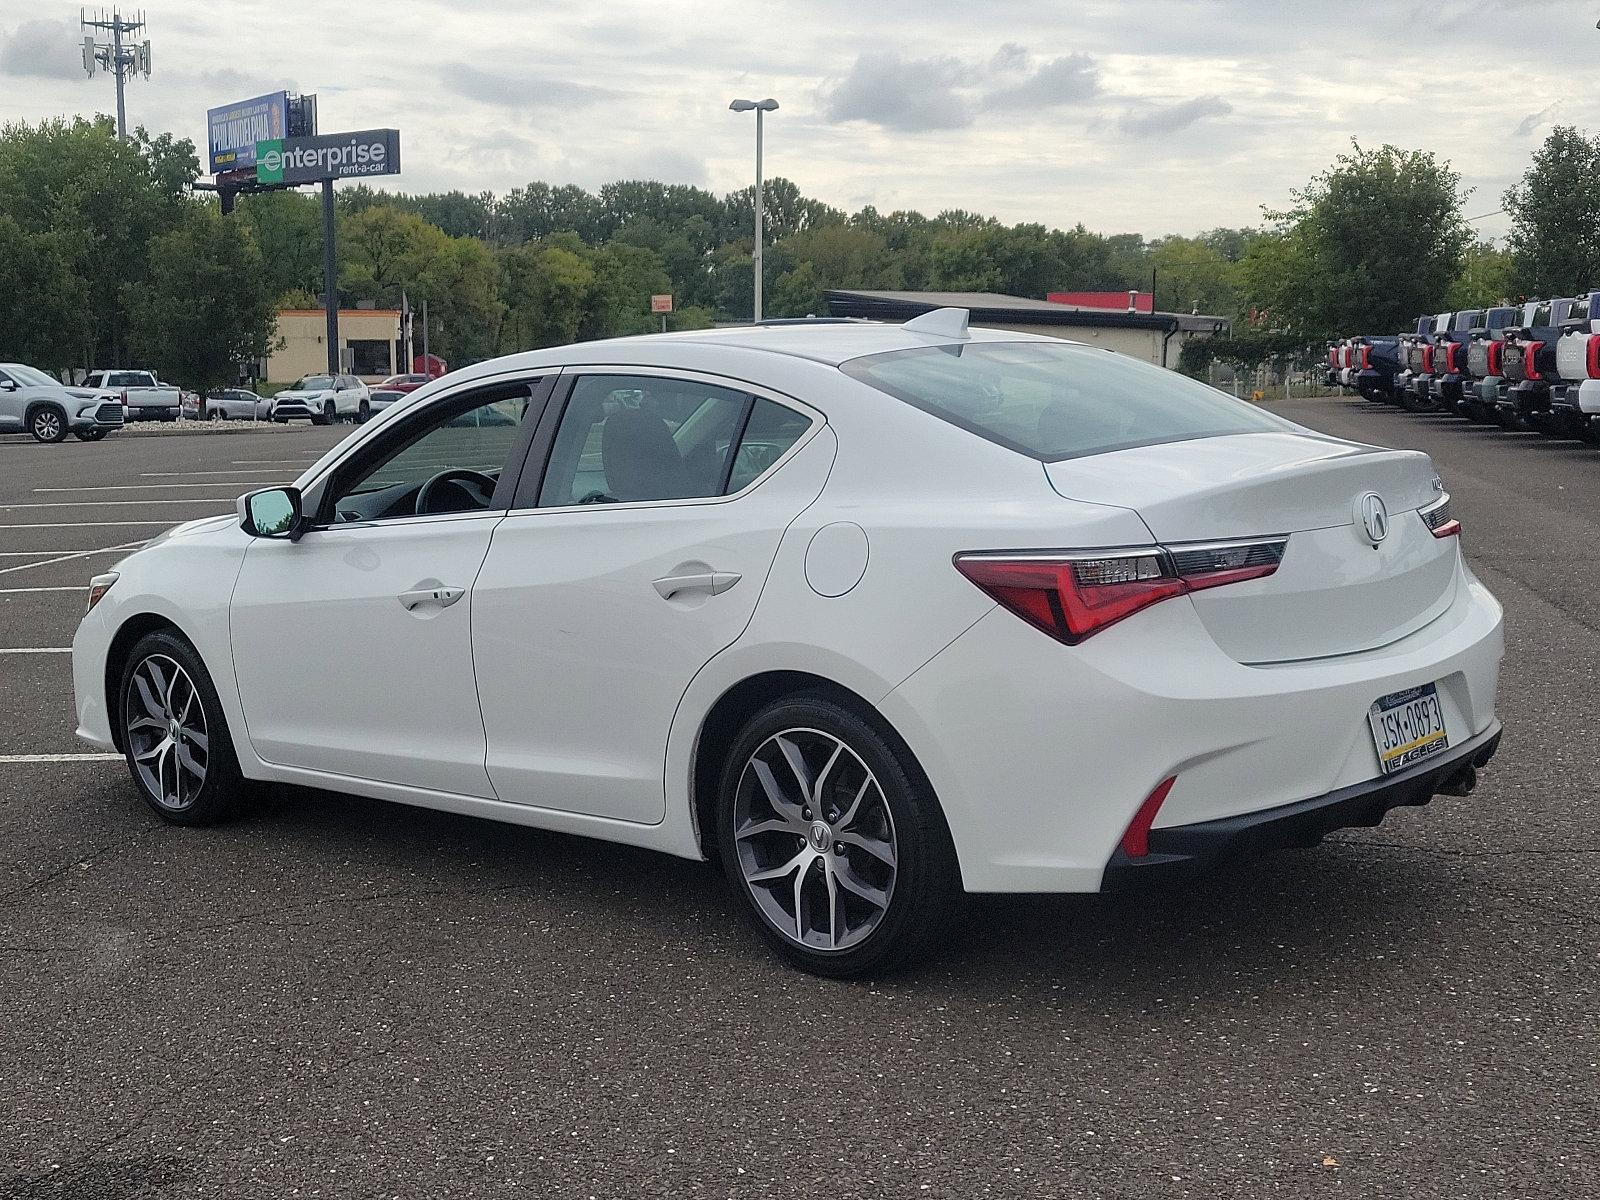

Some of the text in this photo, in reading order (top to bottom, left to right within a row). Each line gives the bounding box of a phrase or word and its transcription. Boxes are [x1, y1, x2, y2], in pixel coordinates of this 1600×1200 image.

[264, 139, 385, 171] enterprise
[339, 162, 385, 175] rent-a-car
[1391, 739, 1443, 767] EAGLES
